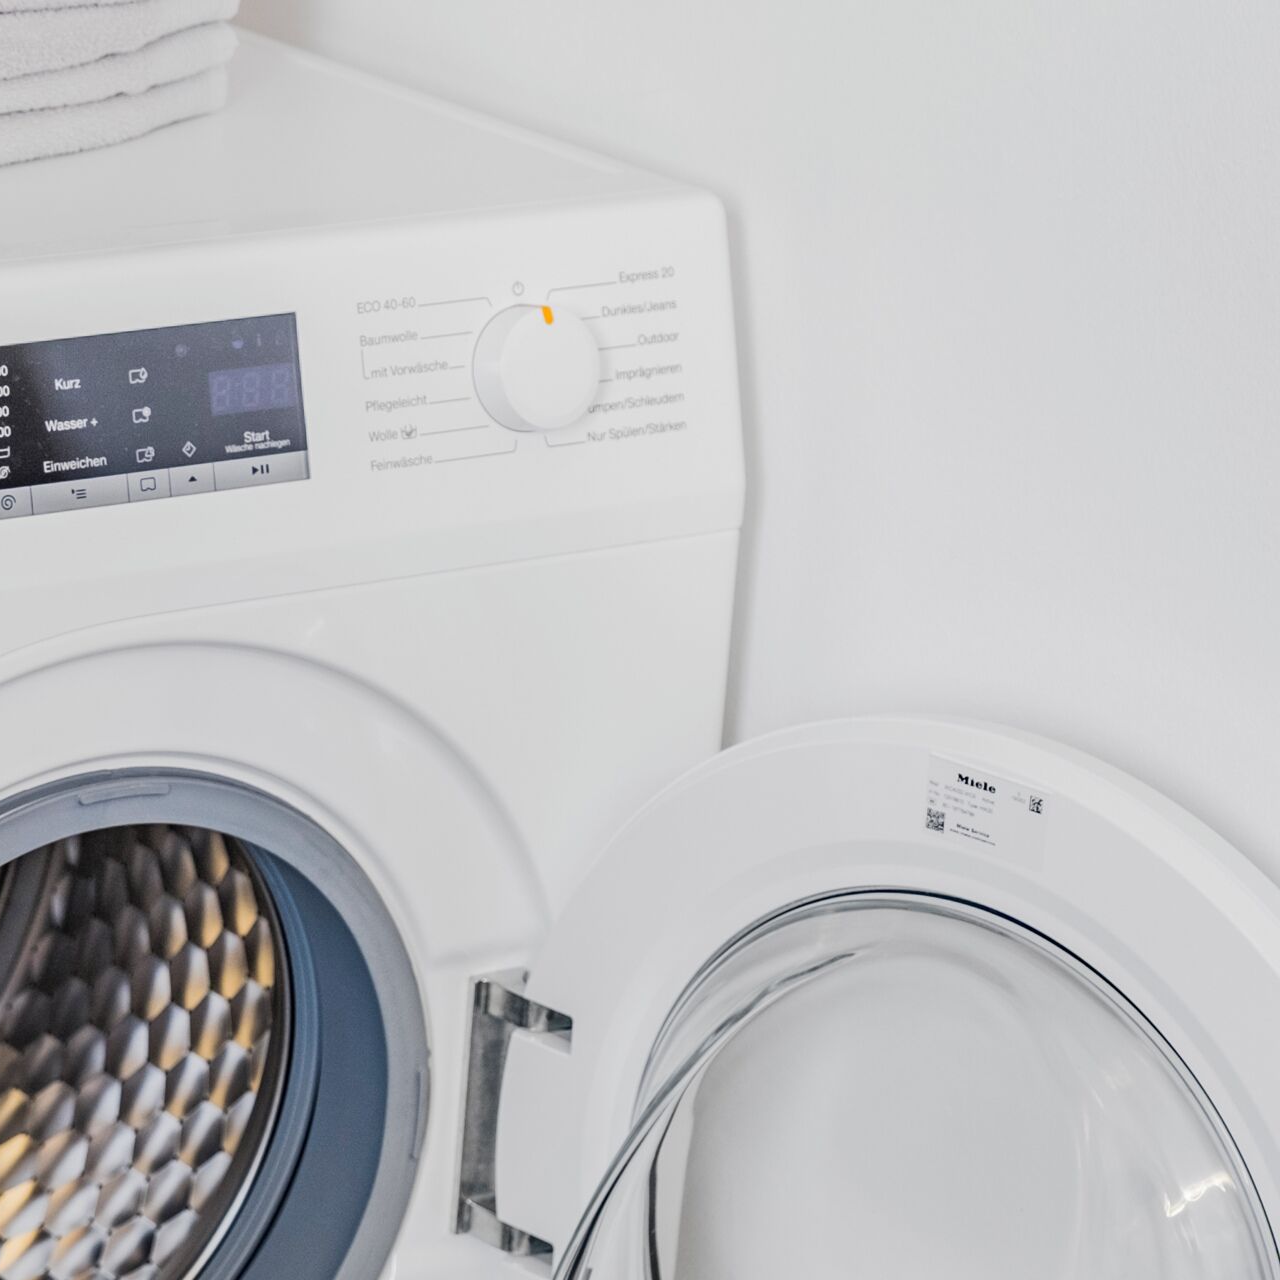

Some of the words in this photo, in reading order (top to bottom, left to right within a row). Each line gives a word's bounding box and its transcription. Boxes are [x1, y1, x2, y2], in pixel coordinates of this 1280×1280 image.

[619, 270, 658, 284] Express
[661, 266, 675, 278] 20
[357, 300, 380, 314] ECO
[383, 296, 416, 310] 40-60
[359, 330, 418, 347] Baumwolle
[370, 367, 388, 379] mit
[54, 378, 81, 391] Kurz
[365, 395, 427, 412] Pflegeleicht
[587, 393, 685, 414] umpen/Schleudern
[44, 418, 88, 432] Wasser
[243, 429, 270, 443] Start
[368, 429, 399, 442] Wolle
[43, 456, 108, 474] Einweichen
[370, 454, 433, 472] Feinwäsche
[957, 773, 996, 794] Miele
